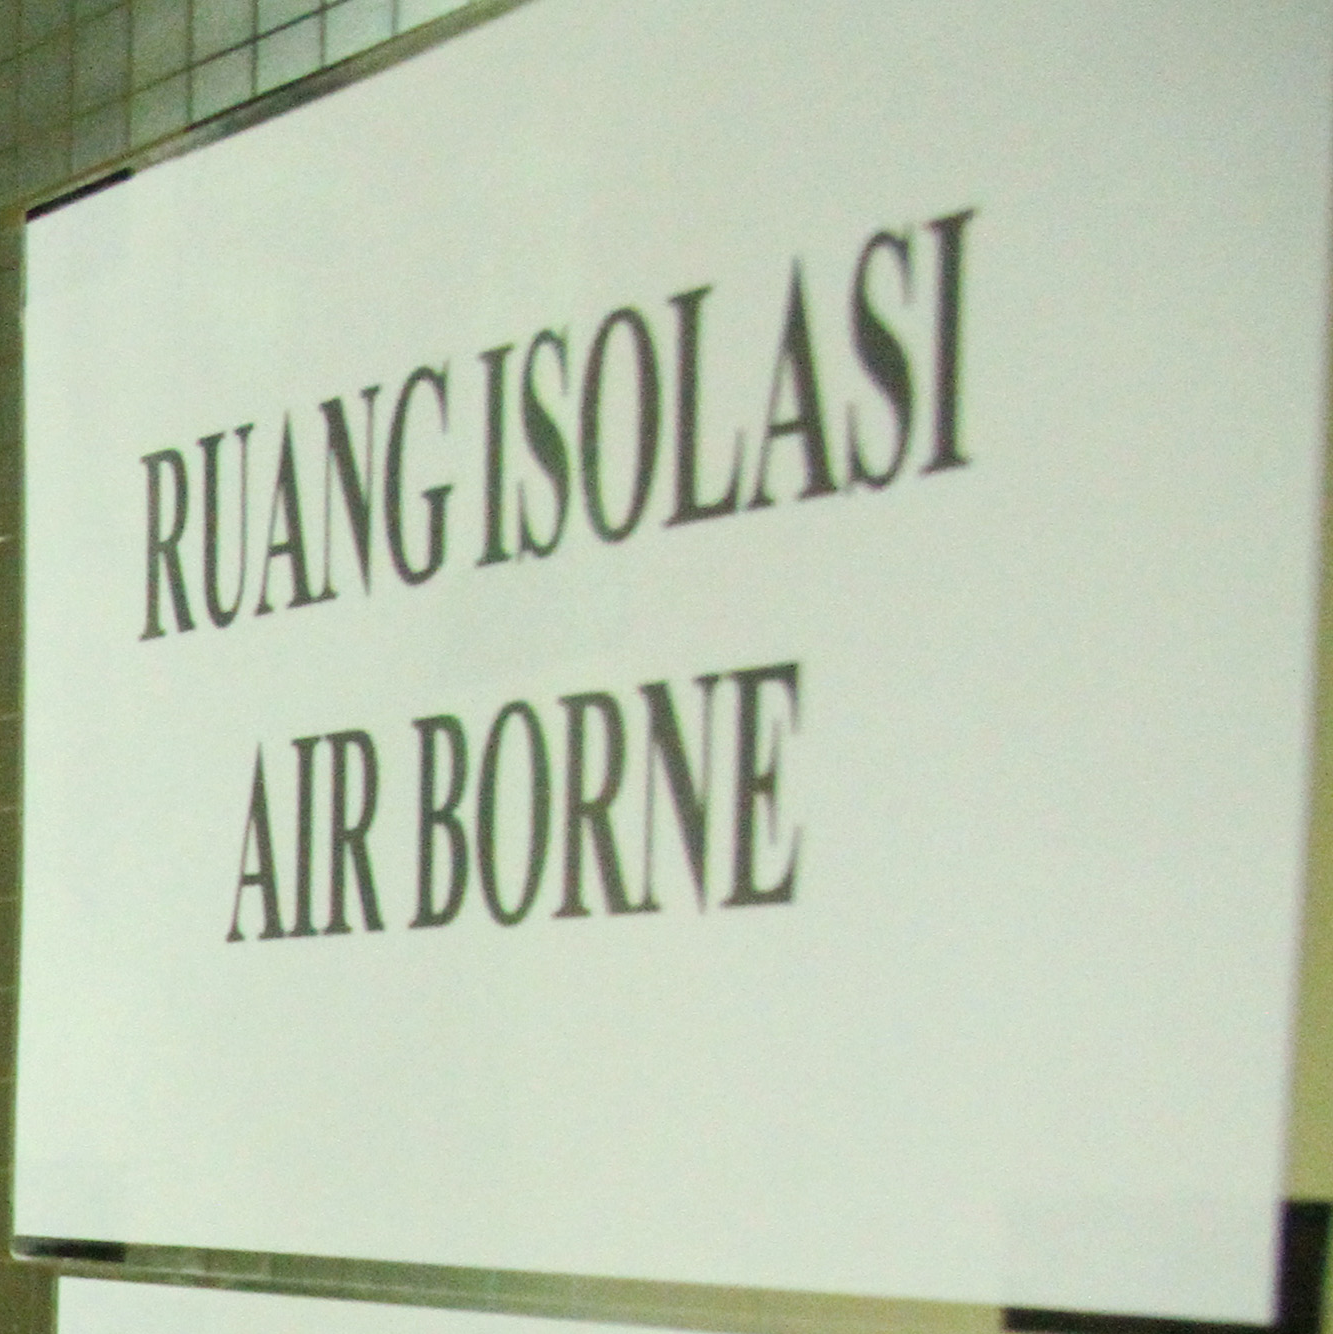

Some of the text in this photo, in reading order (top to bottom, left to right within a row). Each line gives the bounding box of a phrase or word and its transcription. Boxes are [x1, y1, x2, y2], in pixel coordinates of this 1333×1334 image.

[139, 207, 981, 642] RUANG ISOLASI
[226, 662, 804, 943] AIR BORNE
